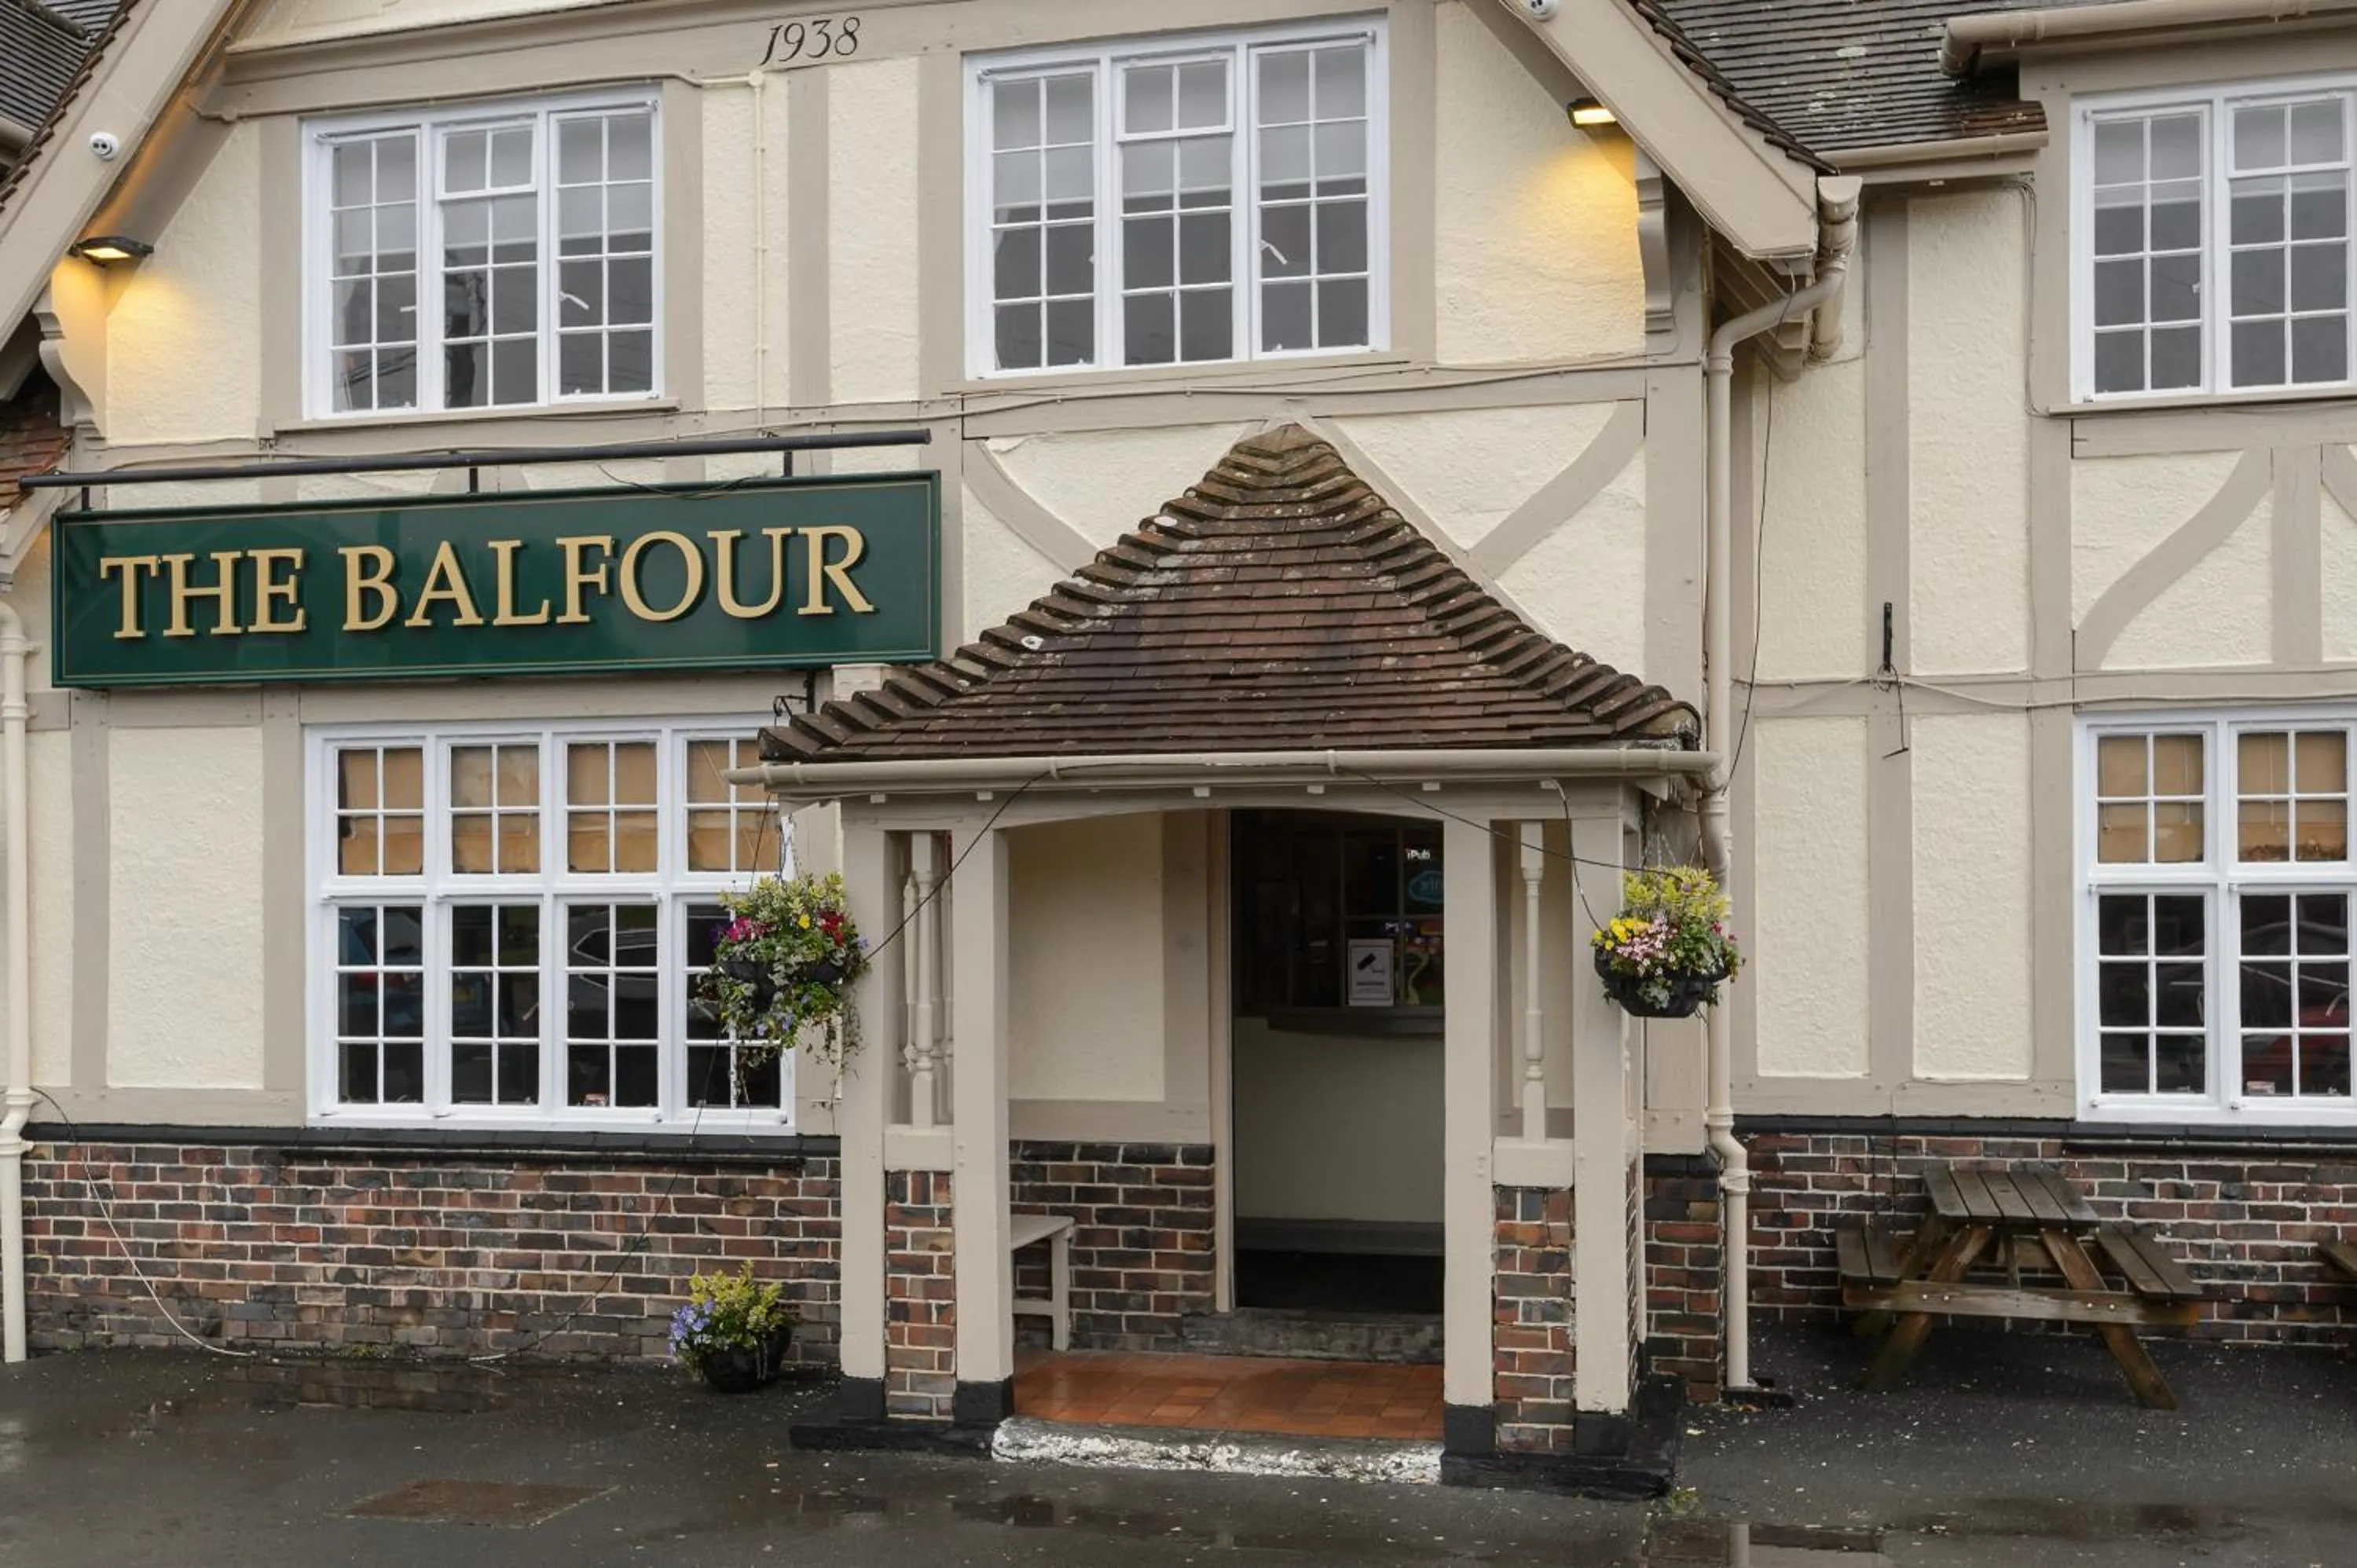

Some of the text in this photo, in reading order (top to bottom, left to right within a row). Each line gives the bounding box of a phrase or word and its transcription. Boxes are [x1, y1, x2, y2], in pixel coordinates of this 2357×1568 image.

[759, 16, 860, 66] 1938
[100, 525, 875, 639] THE BALFOUR
